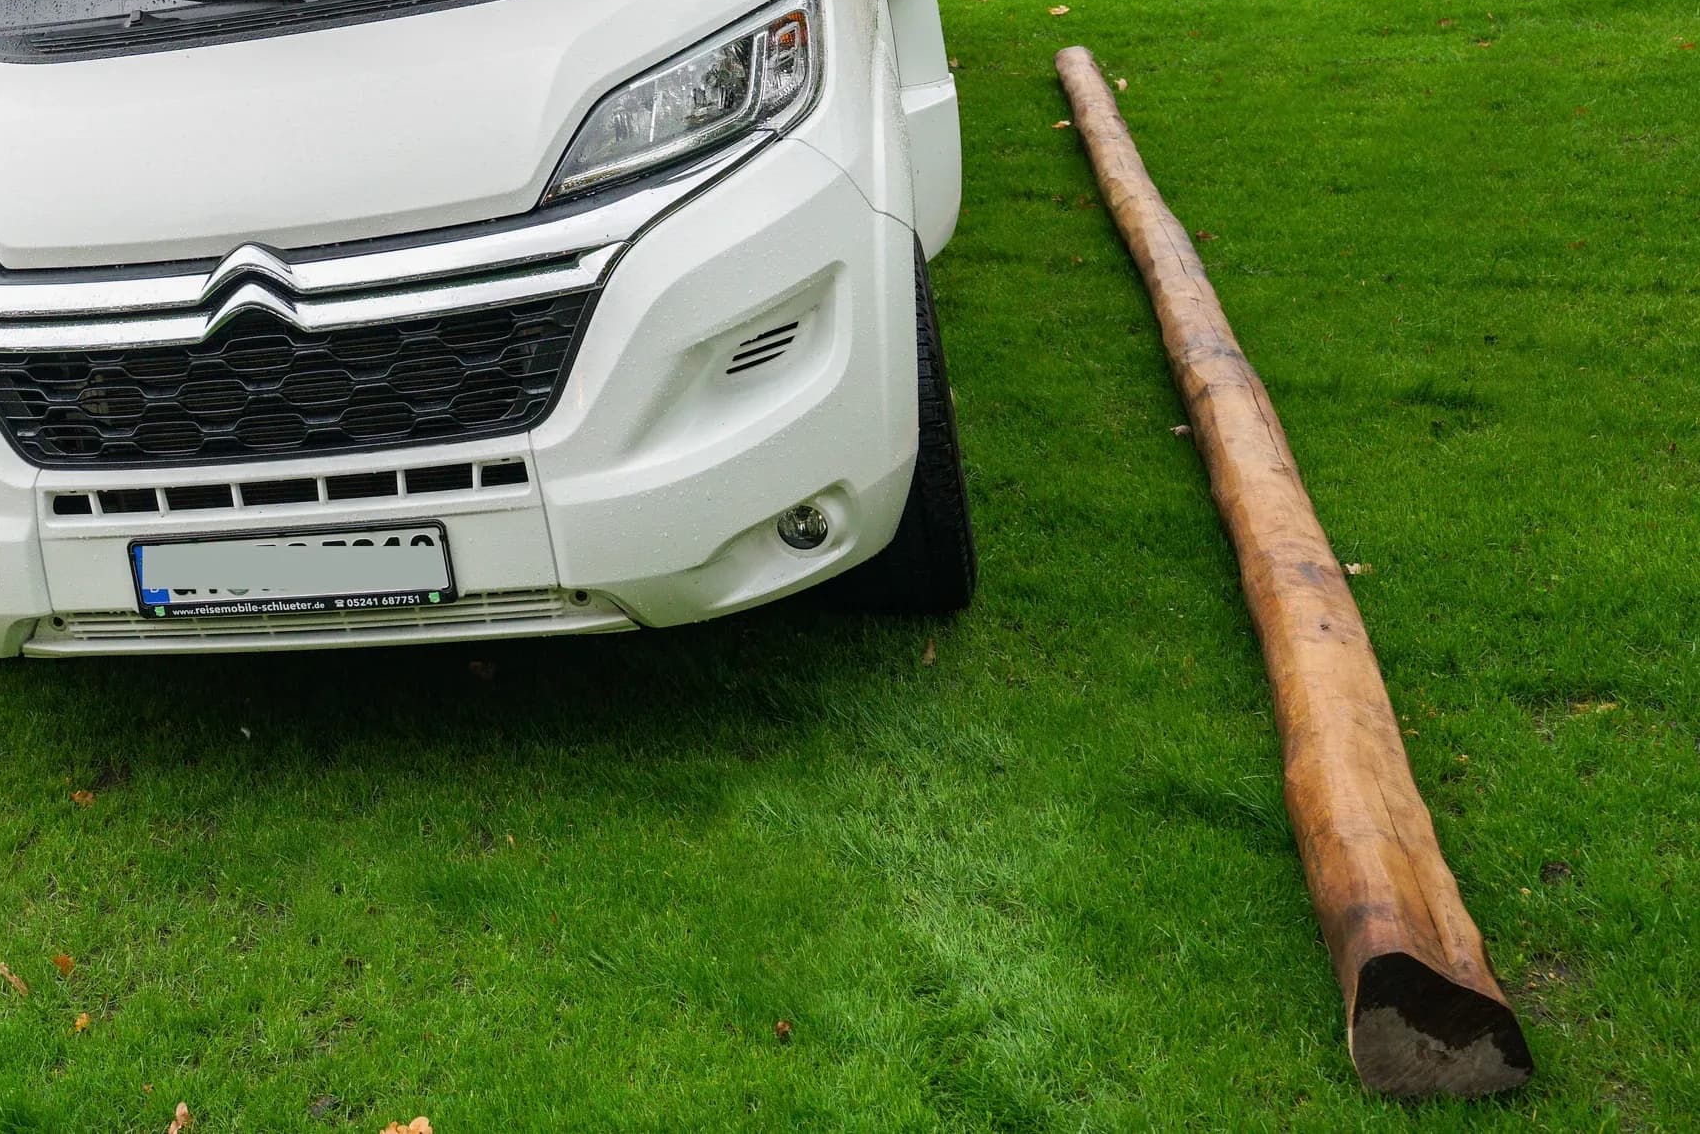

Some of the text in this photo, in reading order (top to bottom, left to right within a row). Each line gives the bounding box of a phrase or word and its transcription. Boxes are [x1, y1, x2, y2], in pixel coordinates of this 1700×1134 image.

[172, 595, 421, 616] www.reisemobile-schlueter.de 05241 687751
